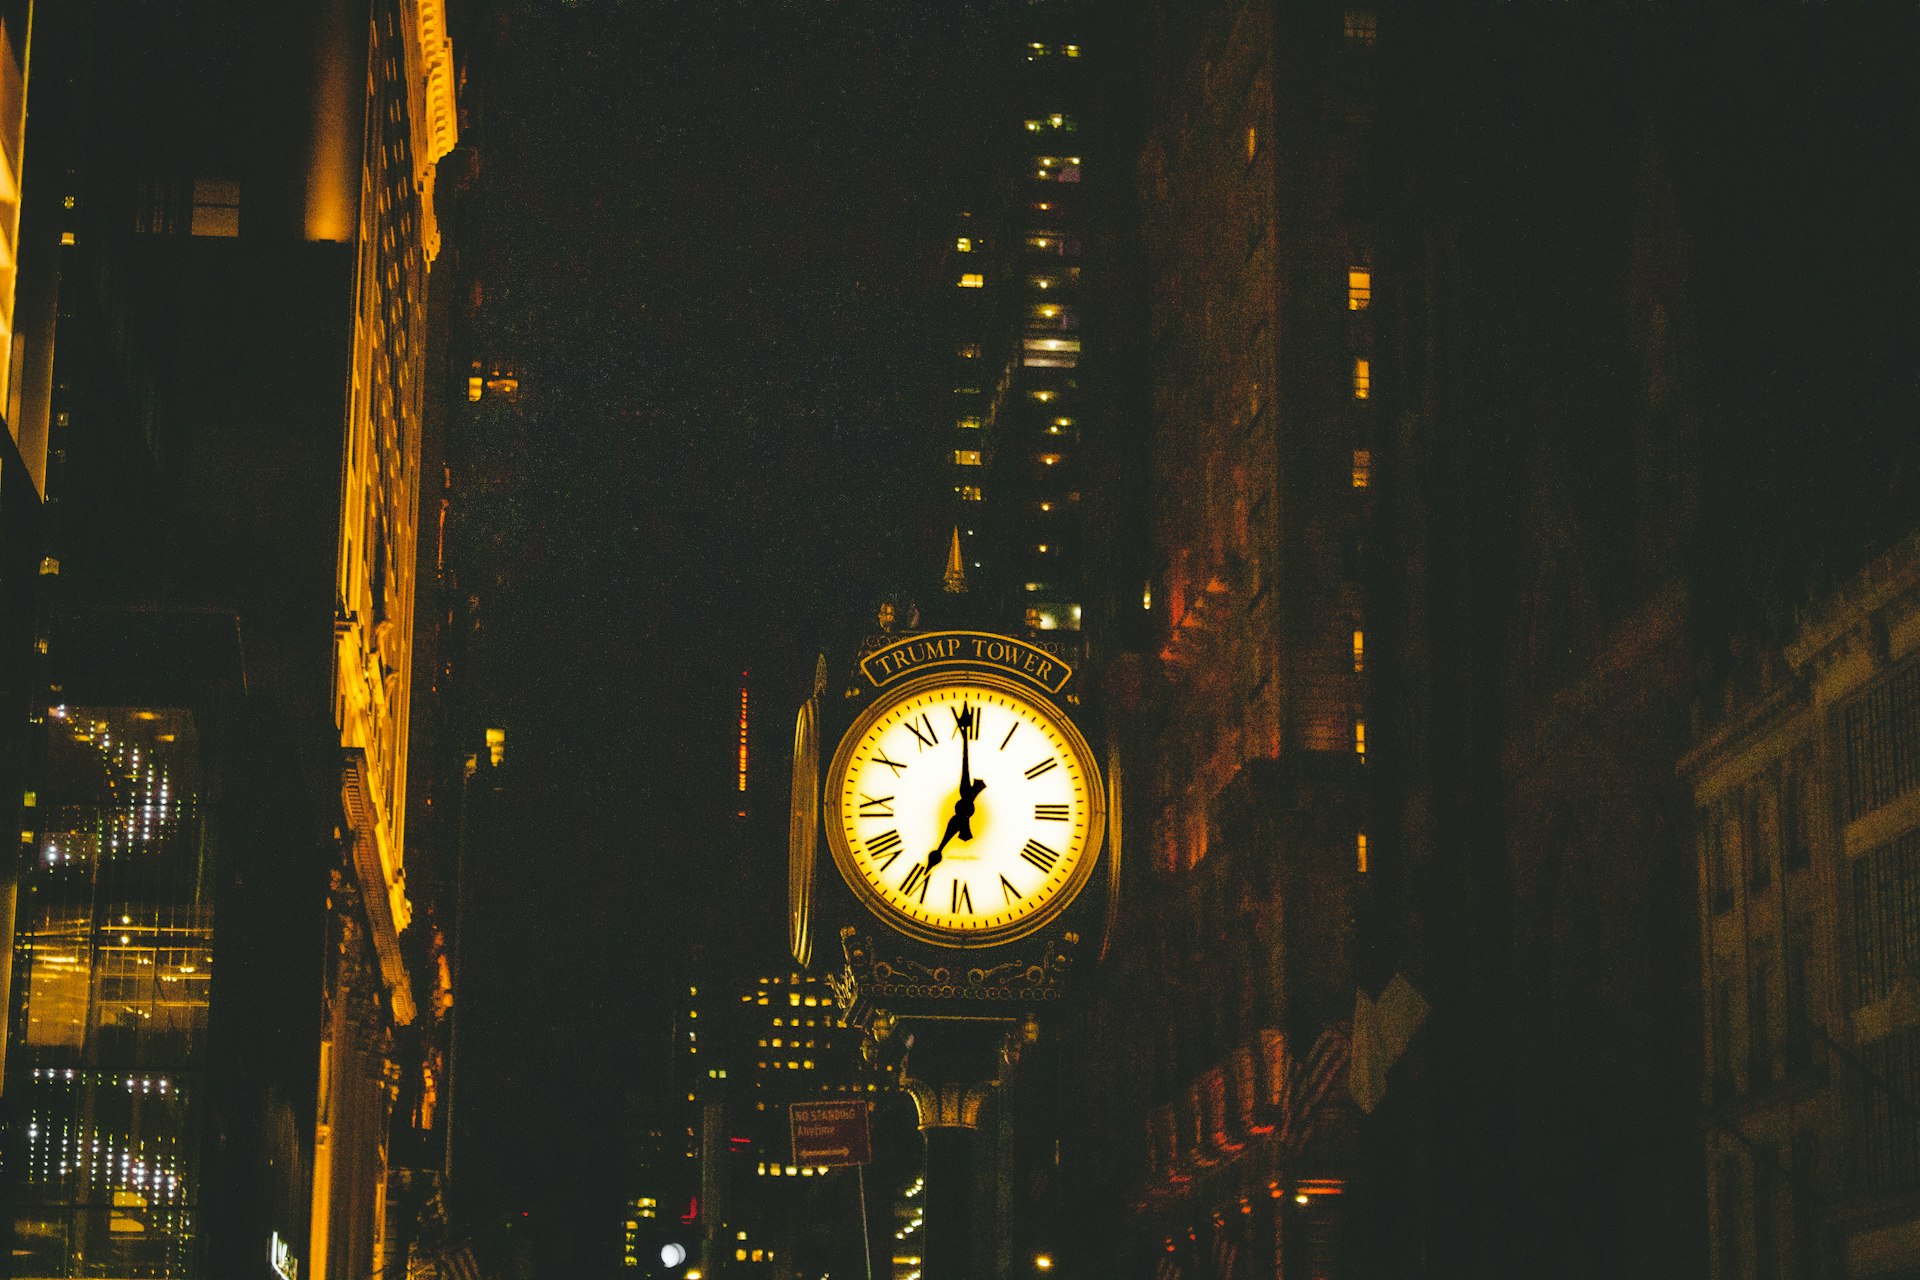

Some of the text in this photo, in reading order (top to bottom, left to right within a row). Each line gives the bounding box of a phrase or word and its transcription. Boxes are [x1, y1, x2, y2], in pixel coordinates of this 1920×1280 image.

[875, 639, 1053, 681] TRUMP TOWER
[904, 713, 939, 753] XI
[999, 721, 1019, 751] I
[871, 747, 908, 779] X
[1024, 757, 1058, 781] II
[859, 792, 895, 818] IX
[1034, 804, 1069, 821] III
[865, 829, 904, 872] VIII
[1019, 838, 1060, 874] IIII
[898, 862, 932, 905] VII
[951, 879, 974, 915] VI
[999, 872, 1022, 906] V
[795, 1108, 856, 1121] NO STANDING
